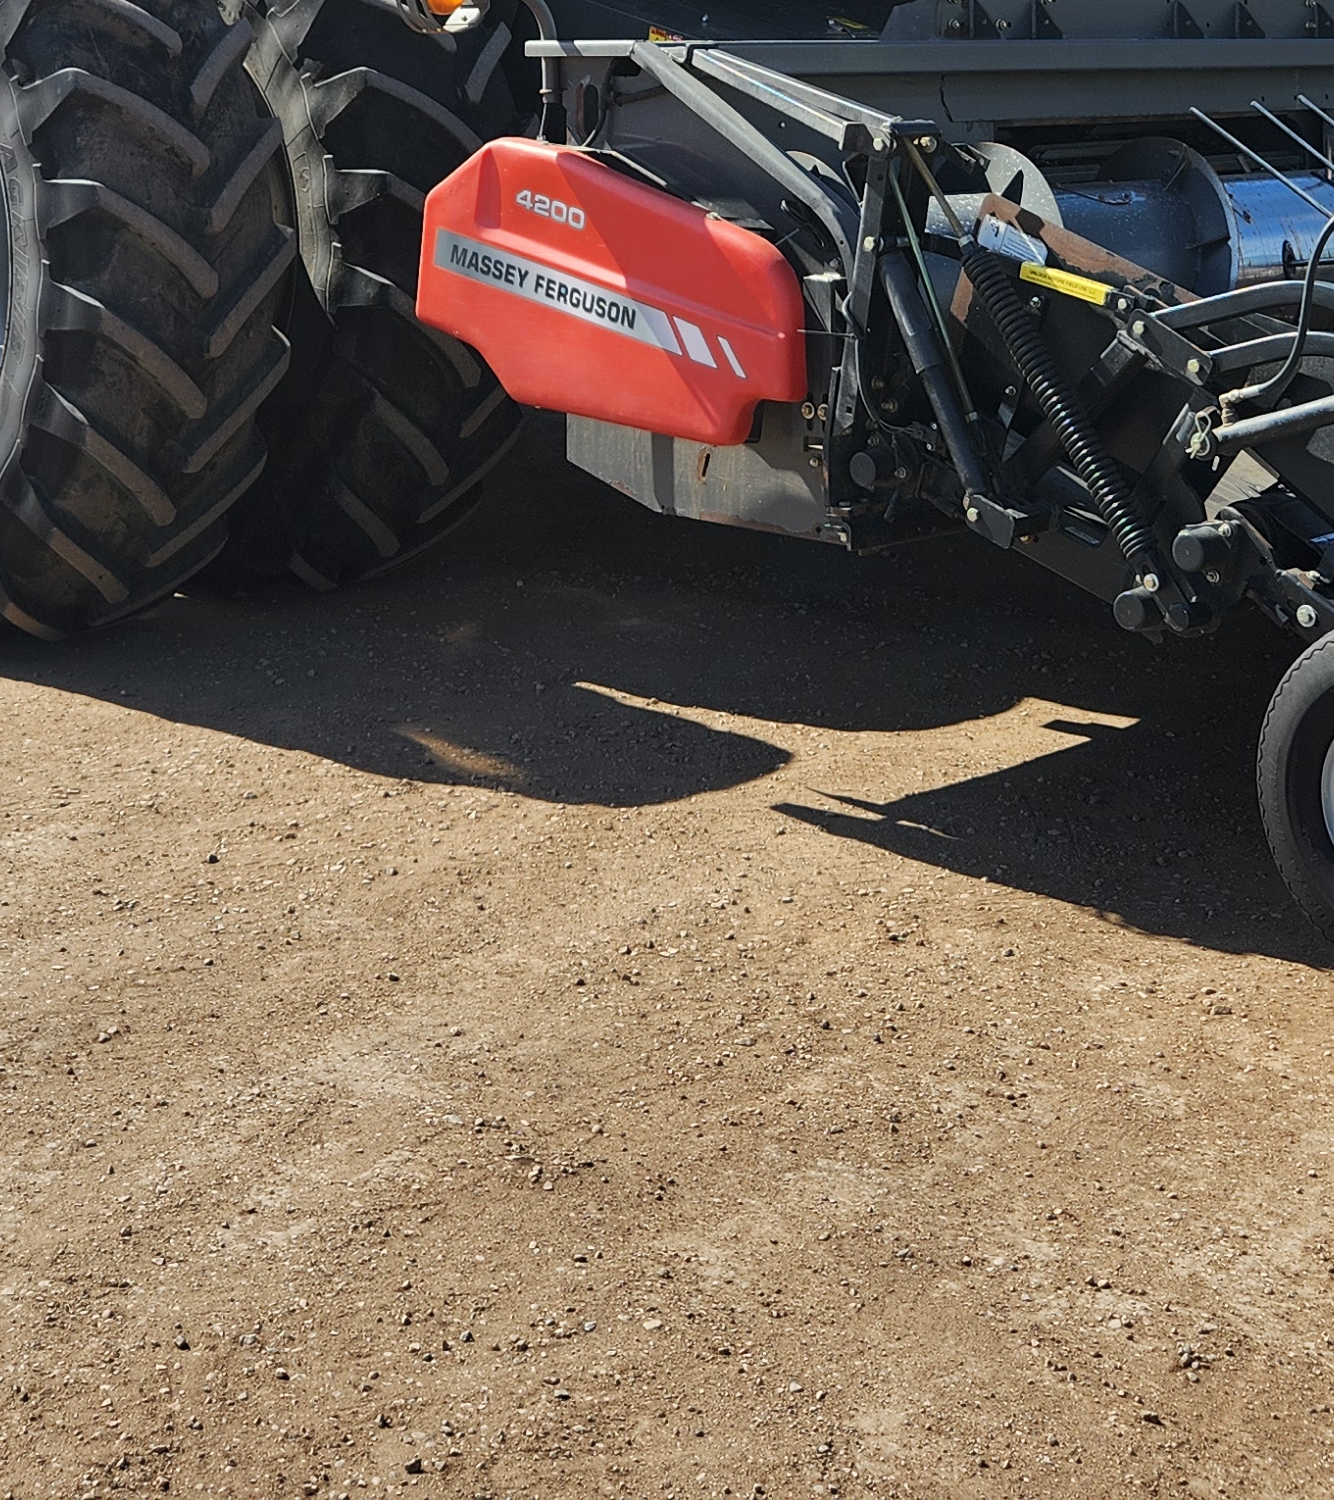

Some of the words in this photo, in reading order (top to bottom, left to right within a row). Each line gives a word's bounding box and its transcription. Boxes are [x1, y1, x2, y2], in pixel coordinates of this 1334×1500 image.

[515, 190, 585, 231] 4200
[450, 244, 529, 290] MASSEY
[534, 275, 638, 330] FERGUSON
